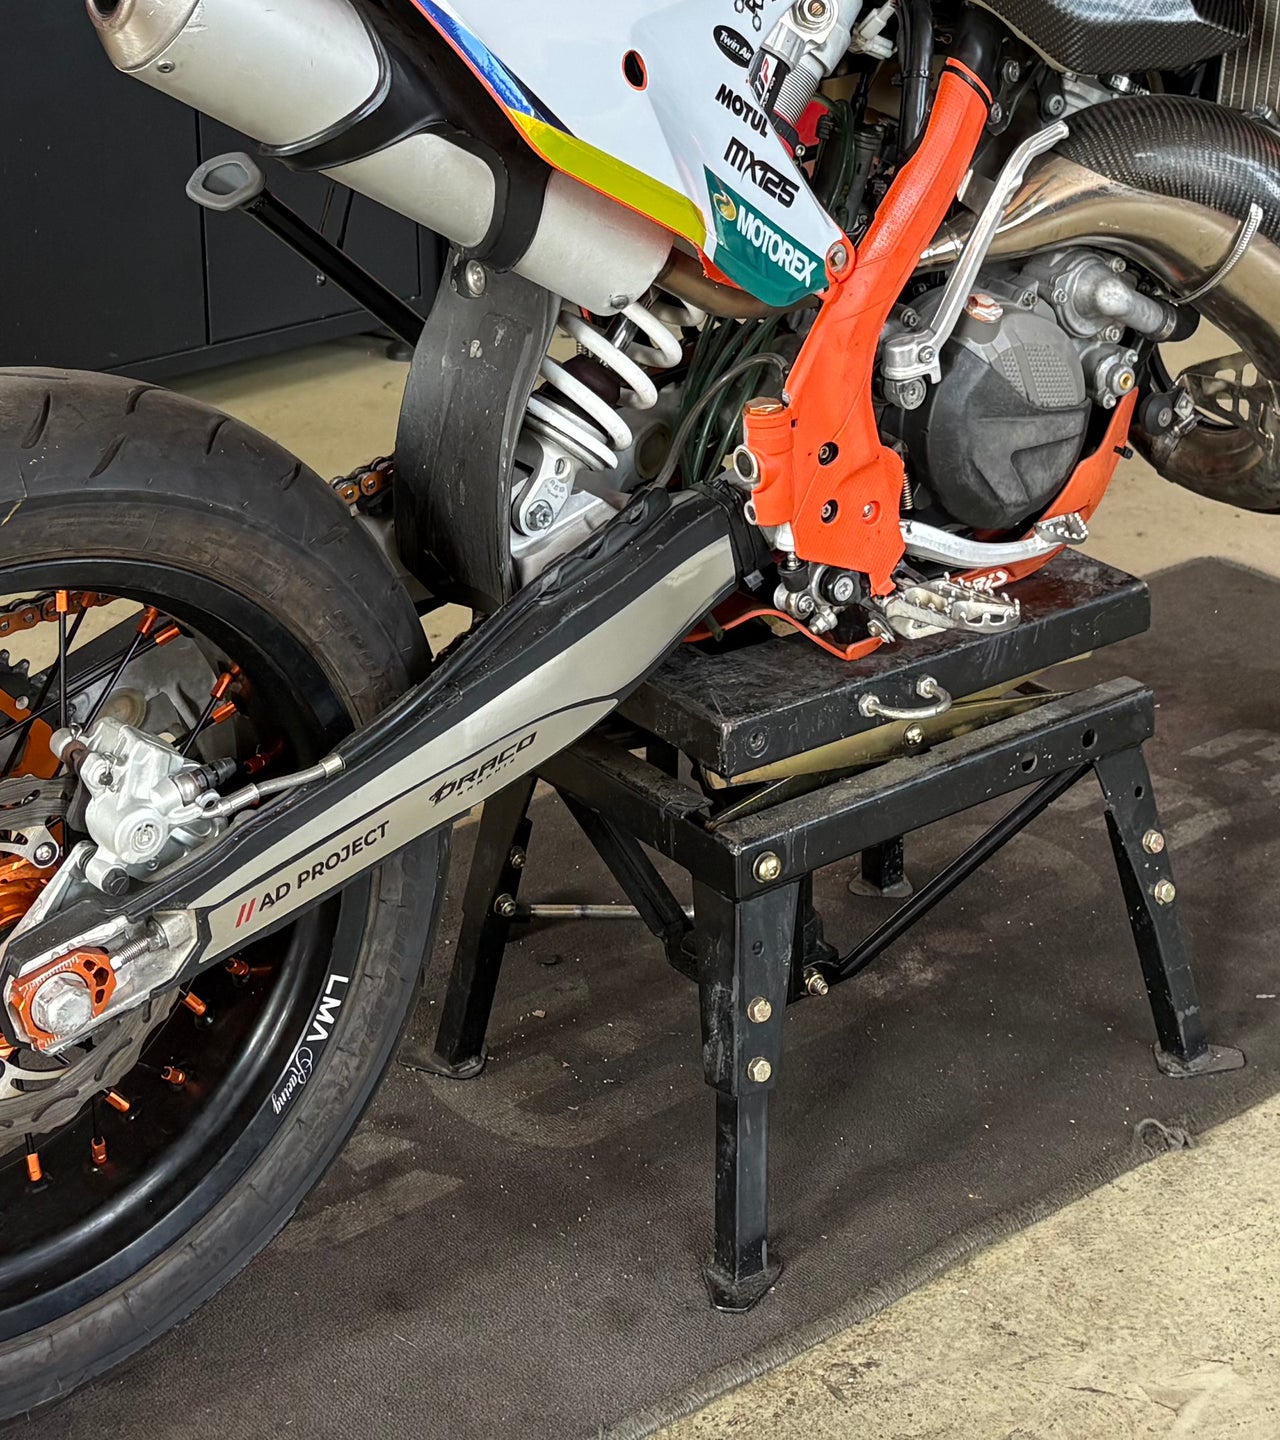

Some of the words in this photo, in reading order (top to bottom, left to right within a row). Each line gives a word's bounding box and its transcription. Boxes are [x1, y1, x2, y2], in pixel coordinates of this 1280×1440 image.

[720, 29, 738, 49] Twin
[715, 83, 768, 138] MOTUL
[724, 137, 800, 208] MX125
[737, 205, 817, 288] MOTOREX
[428, 731, 537, 808] DRACO
[296, 820, 390, 890] PROJECT
[306, 974, 349, 1042] LMA
[271, 1046, 313, 1115] Racing
